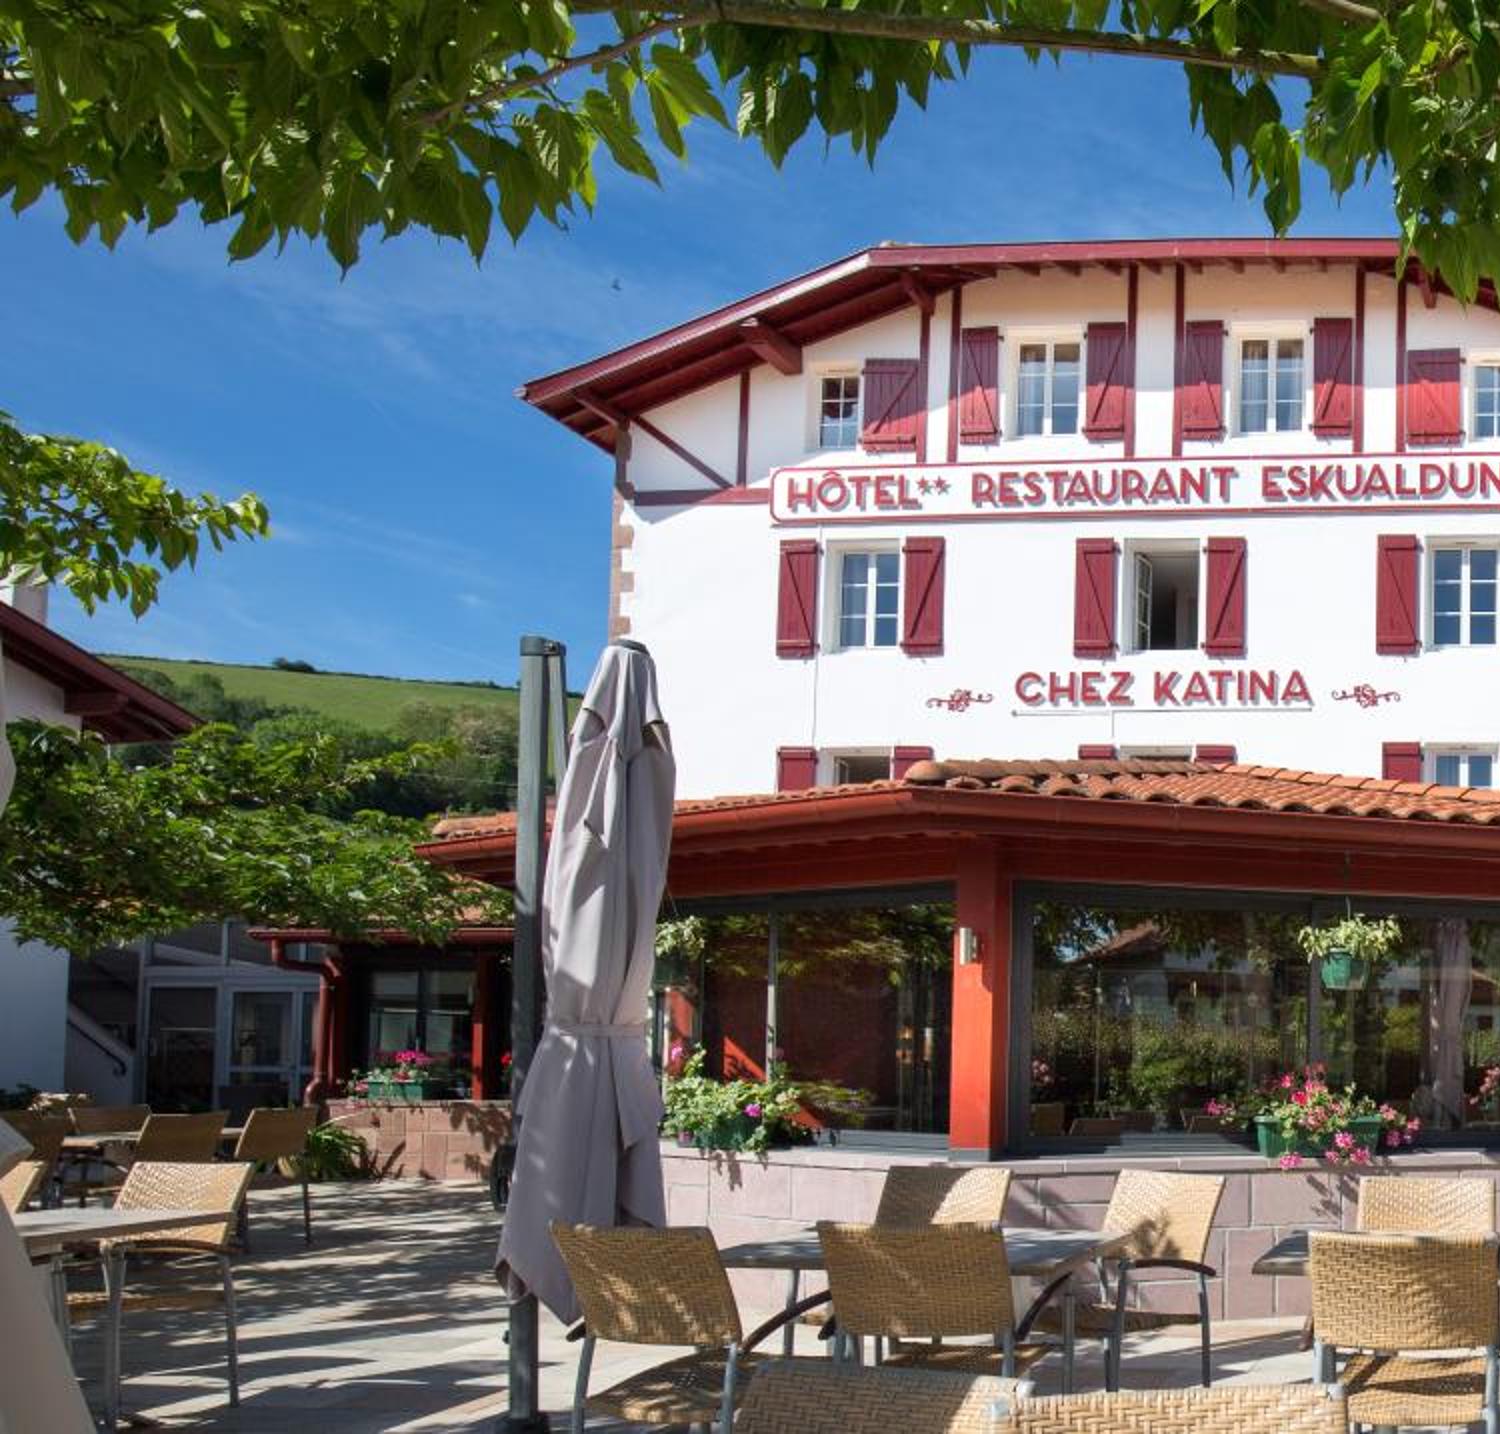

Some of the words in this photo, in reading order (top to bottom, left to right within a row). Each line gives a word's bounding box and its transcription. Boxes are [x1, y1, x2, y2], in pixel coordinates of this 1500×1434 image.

[971, 467, 1238, 508] RESTAURANT
[1014, 671, 1135, 707] CHEZ
[1153, 670, 1315, 706] KATINA
